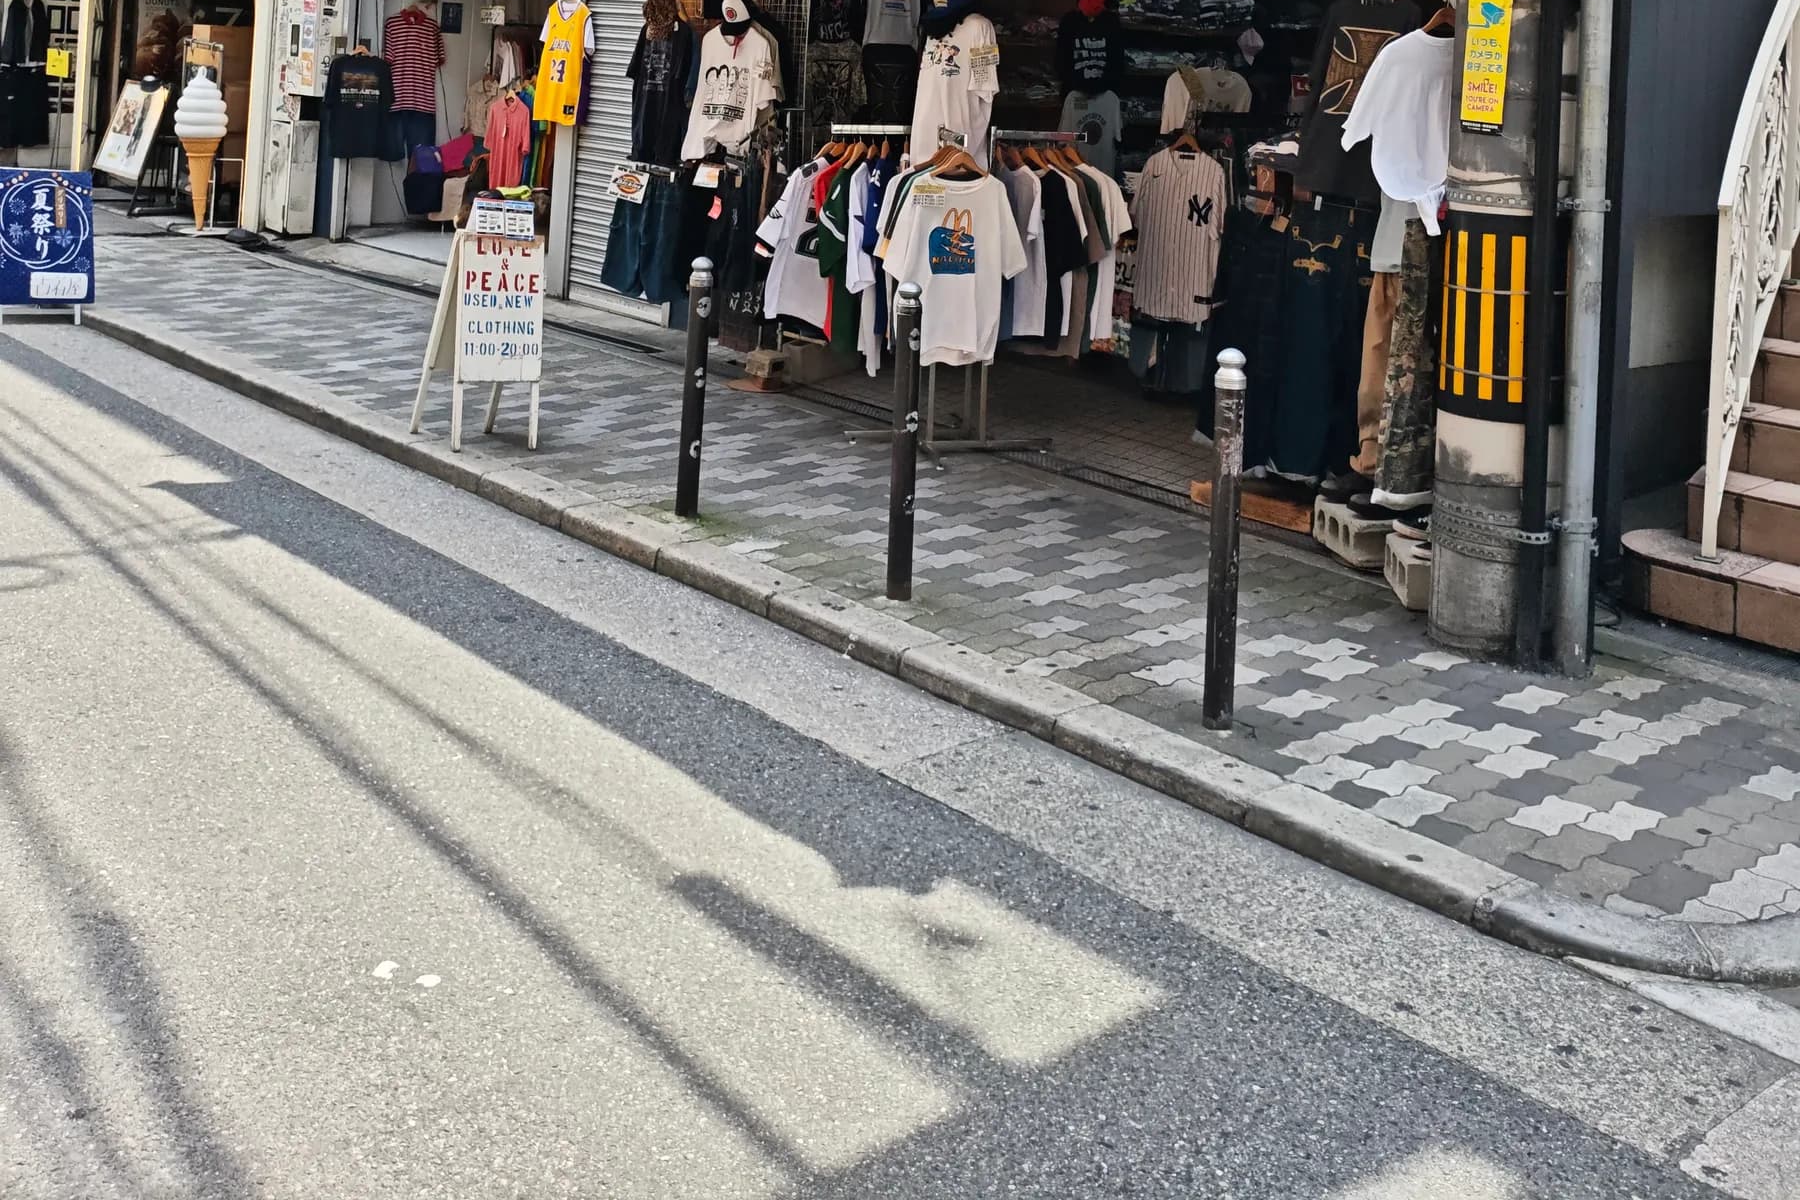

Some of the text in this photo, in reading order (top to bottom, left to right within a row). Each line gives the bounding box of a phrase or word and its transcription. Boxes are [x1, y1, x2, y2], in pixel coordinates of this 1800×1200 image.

[30, 188, 55, 260] 夏祭り
[500, 258, 509, 271] &
[465, 270, 540, 294] PEACE
[464, 293, 497, 308] USED
[505, 295, 533, 309] NEW
[468, 320, 535, 336] CLOTHING
